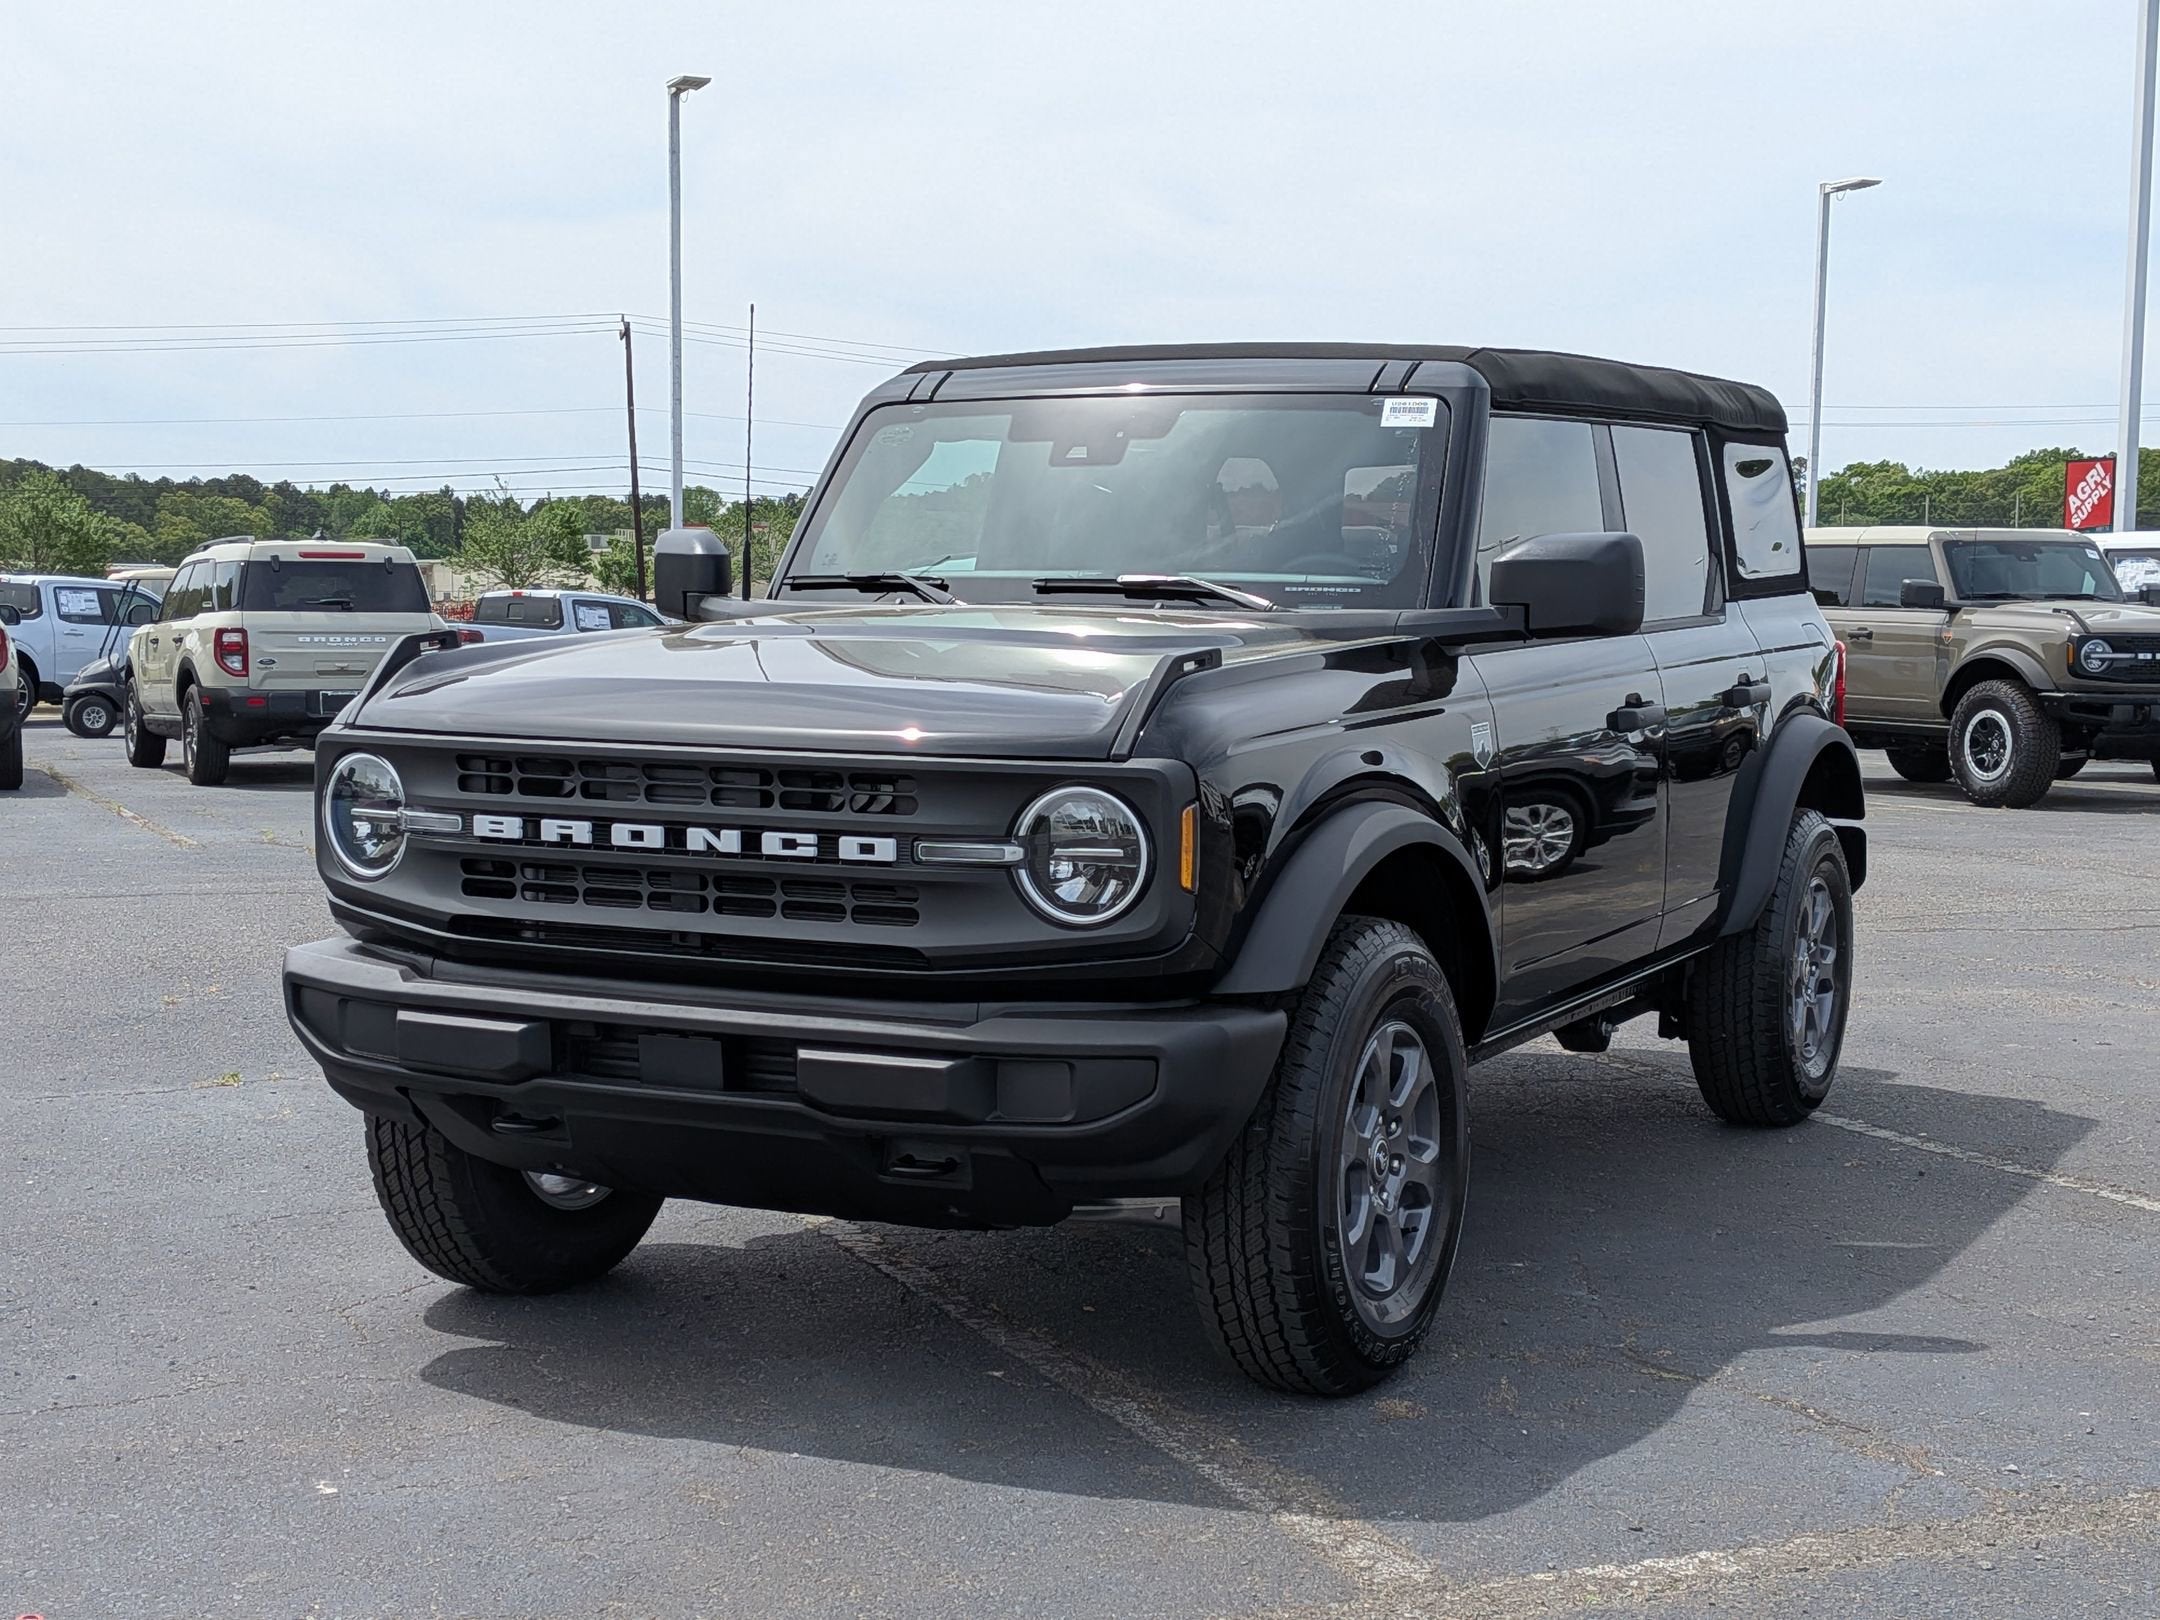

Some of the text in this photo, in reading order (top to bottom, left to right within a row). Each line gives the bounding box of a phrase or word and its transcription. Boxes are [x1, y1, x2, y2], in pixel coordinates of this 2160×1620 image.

[2068, 462, 2106, 515] AGRI
[2071, 472, 2112, 528] SUPPLY
[472, 814, 898, 863] BRONCO
